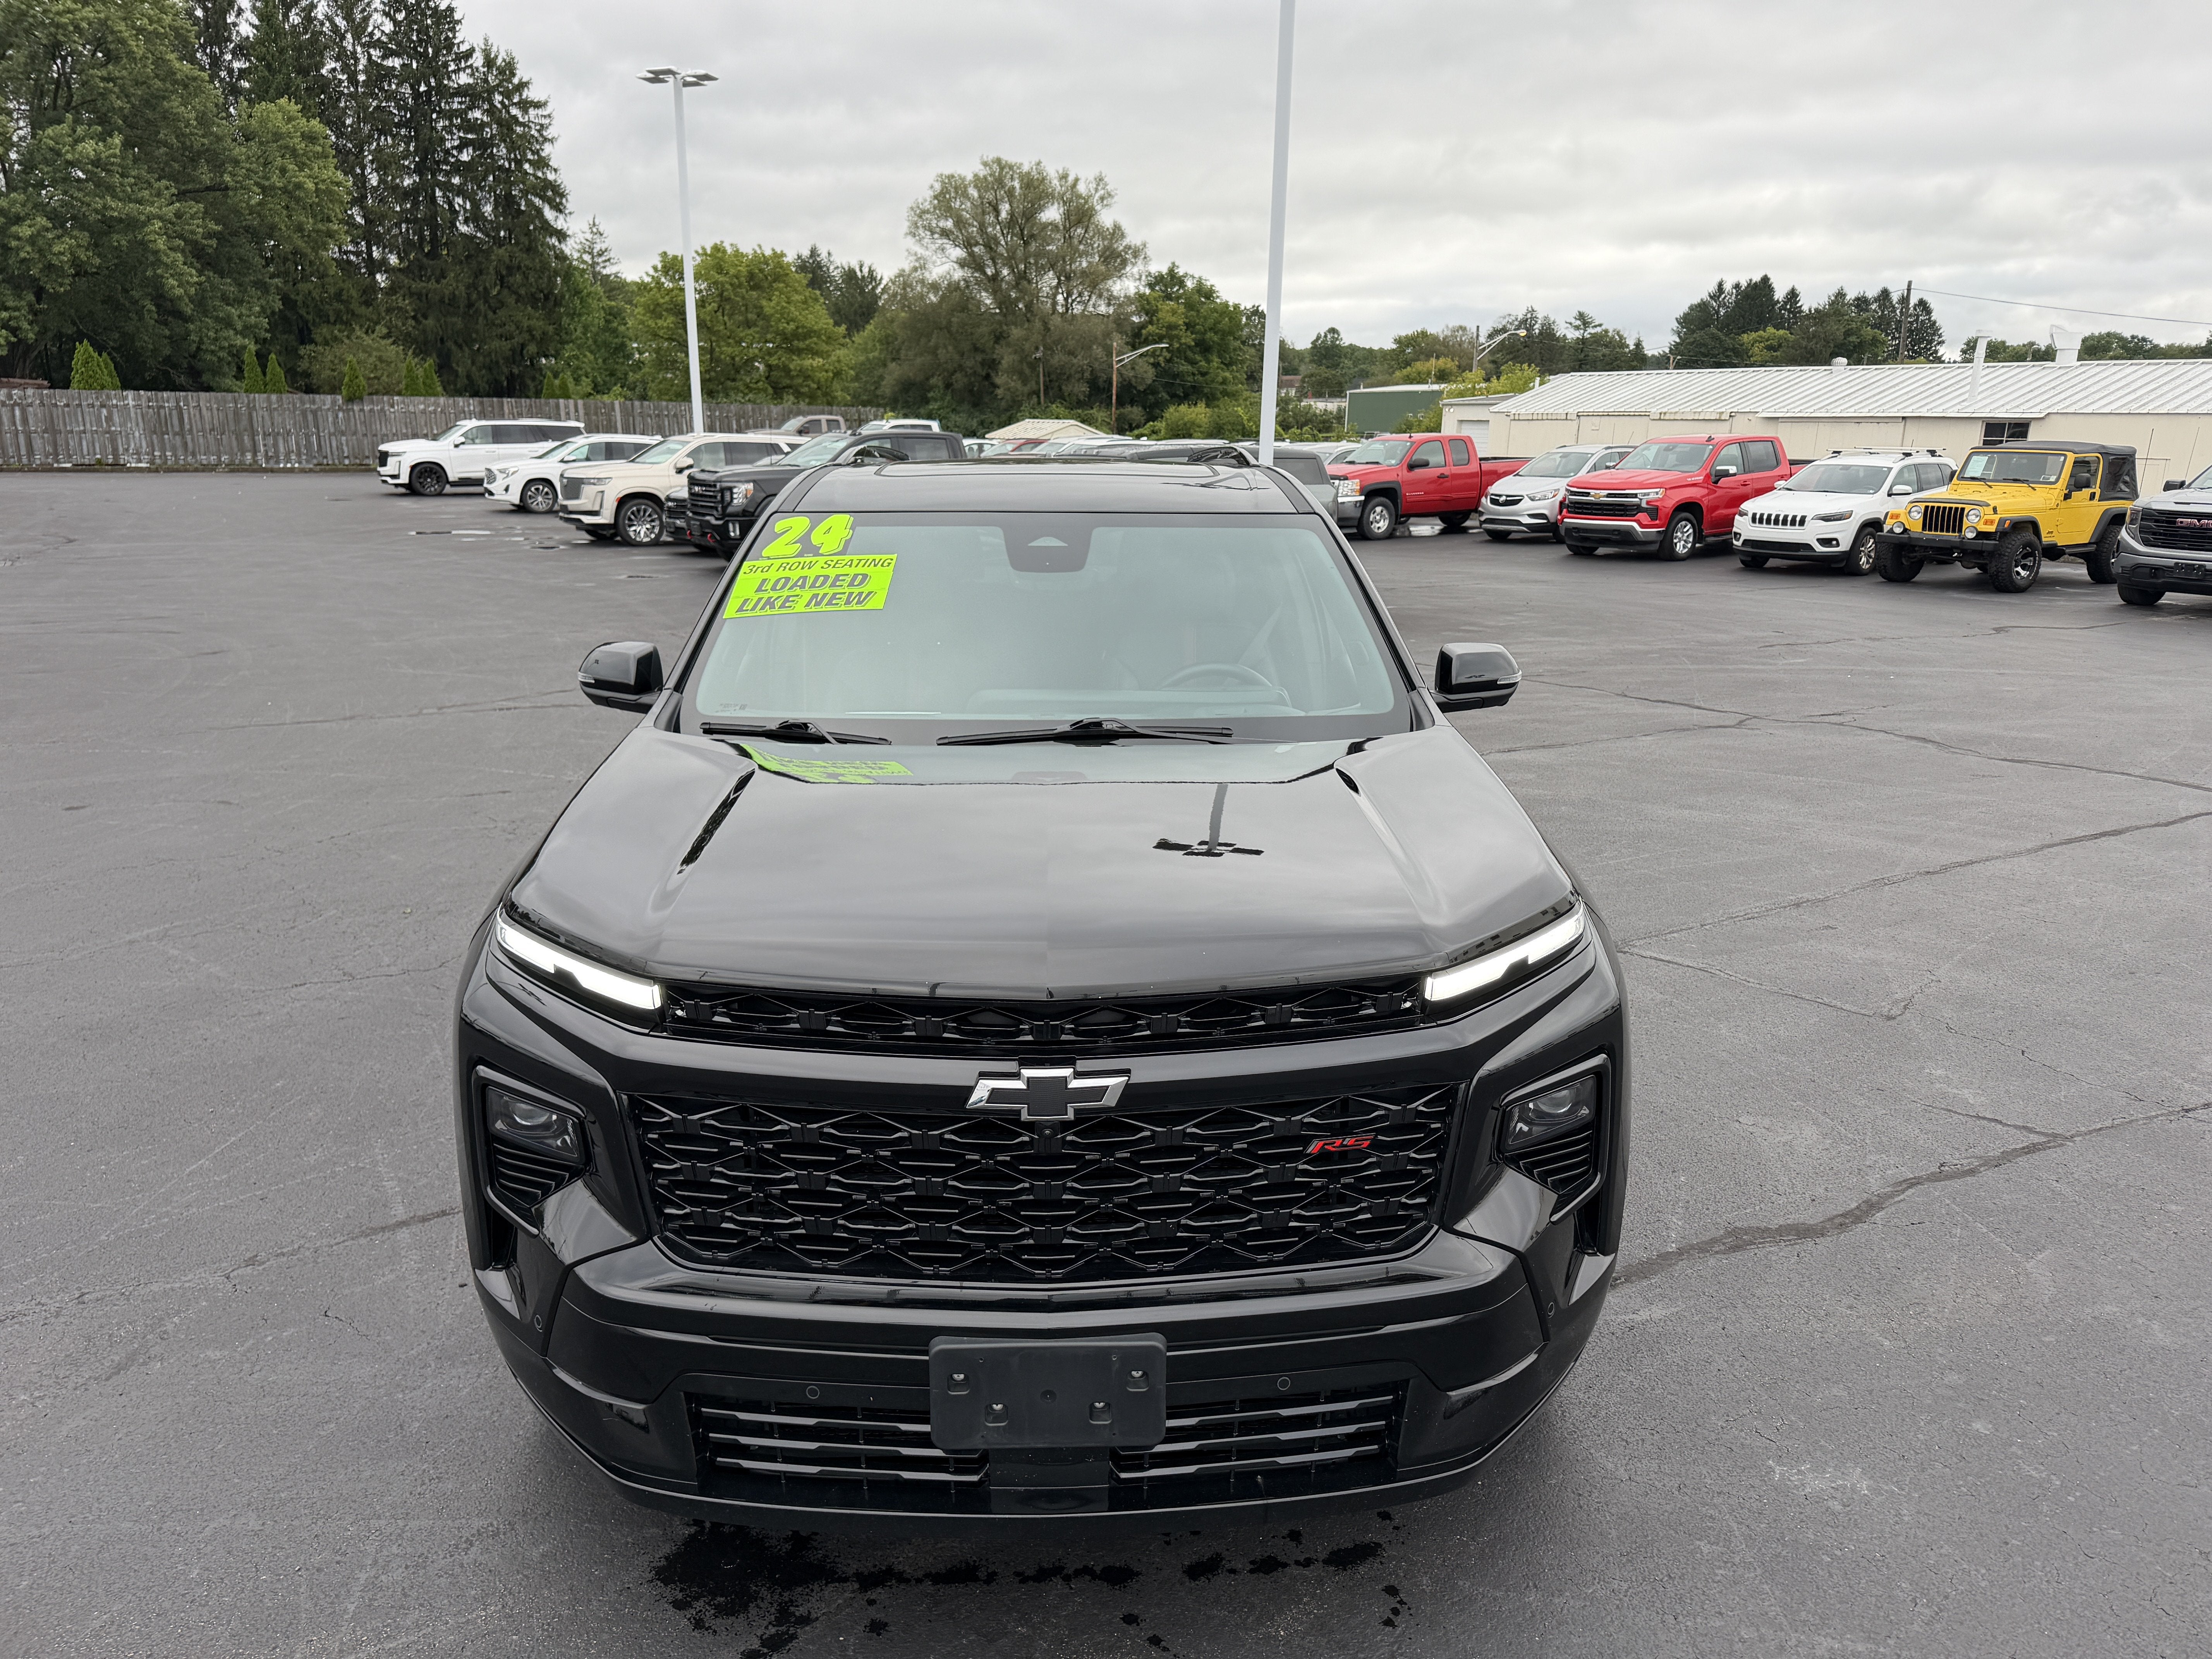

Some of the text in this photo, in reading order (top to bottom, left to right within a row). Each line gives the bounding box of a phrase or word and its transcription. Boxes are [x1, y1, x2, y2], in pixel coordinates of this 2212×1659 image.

[762, 514, 854, 558] 24
[743, 558, 893, 575] 3rd ROW SEATING
[754, 573, 872, 595] LOADED
[735, 591, 877, 615] LIKE NEW
[1306, 1135, 1375, 1154] RS
